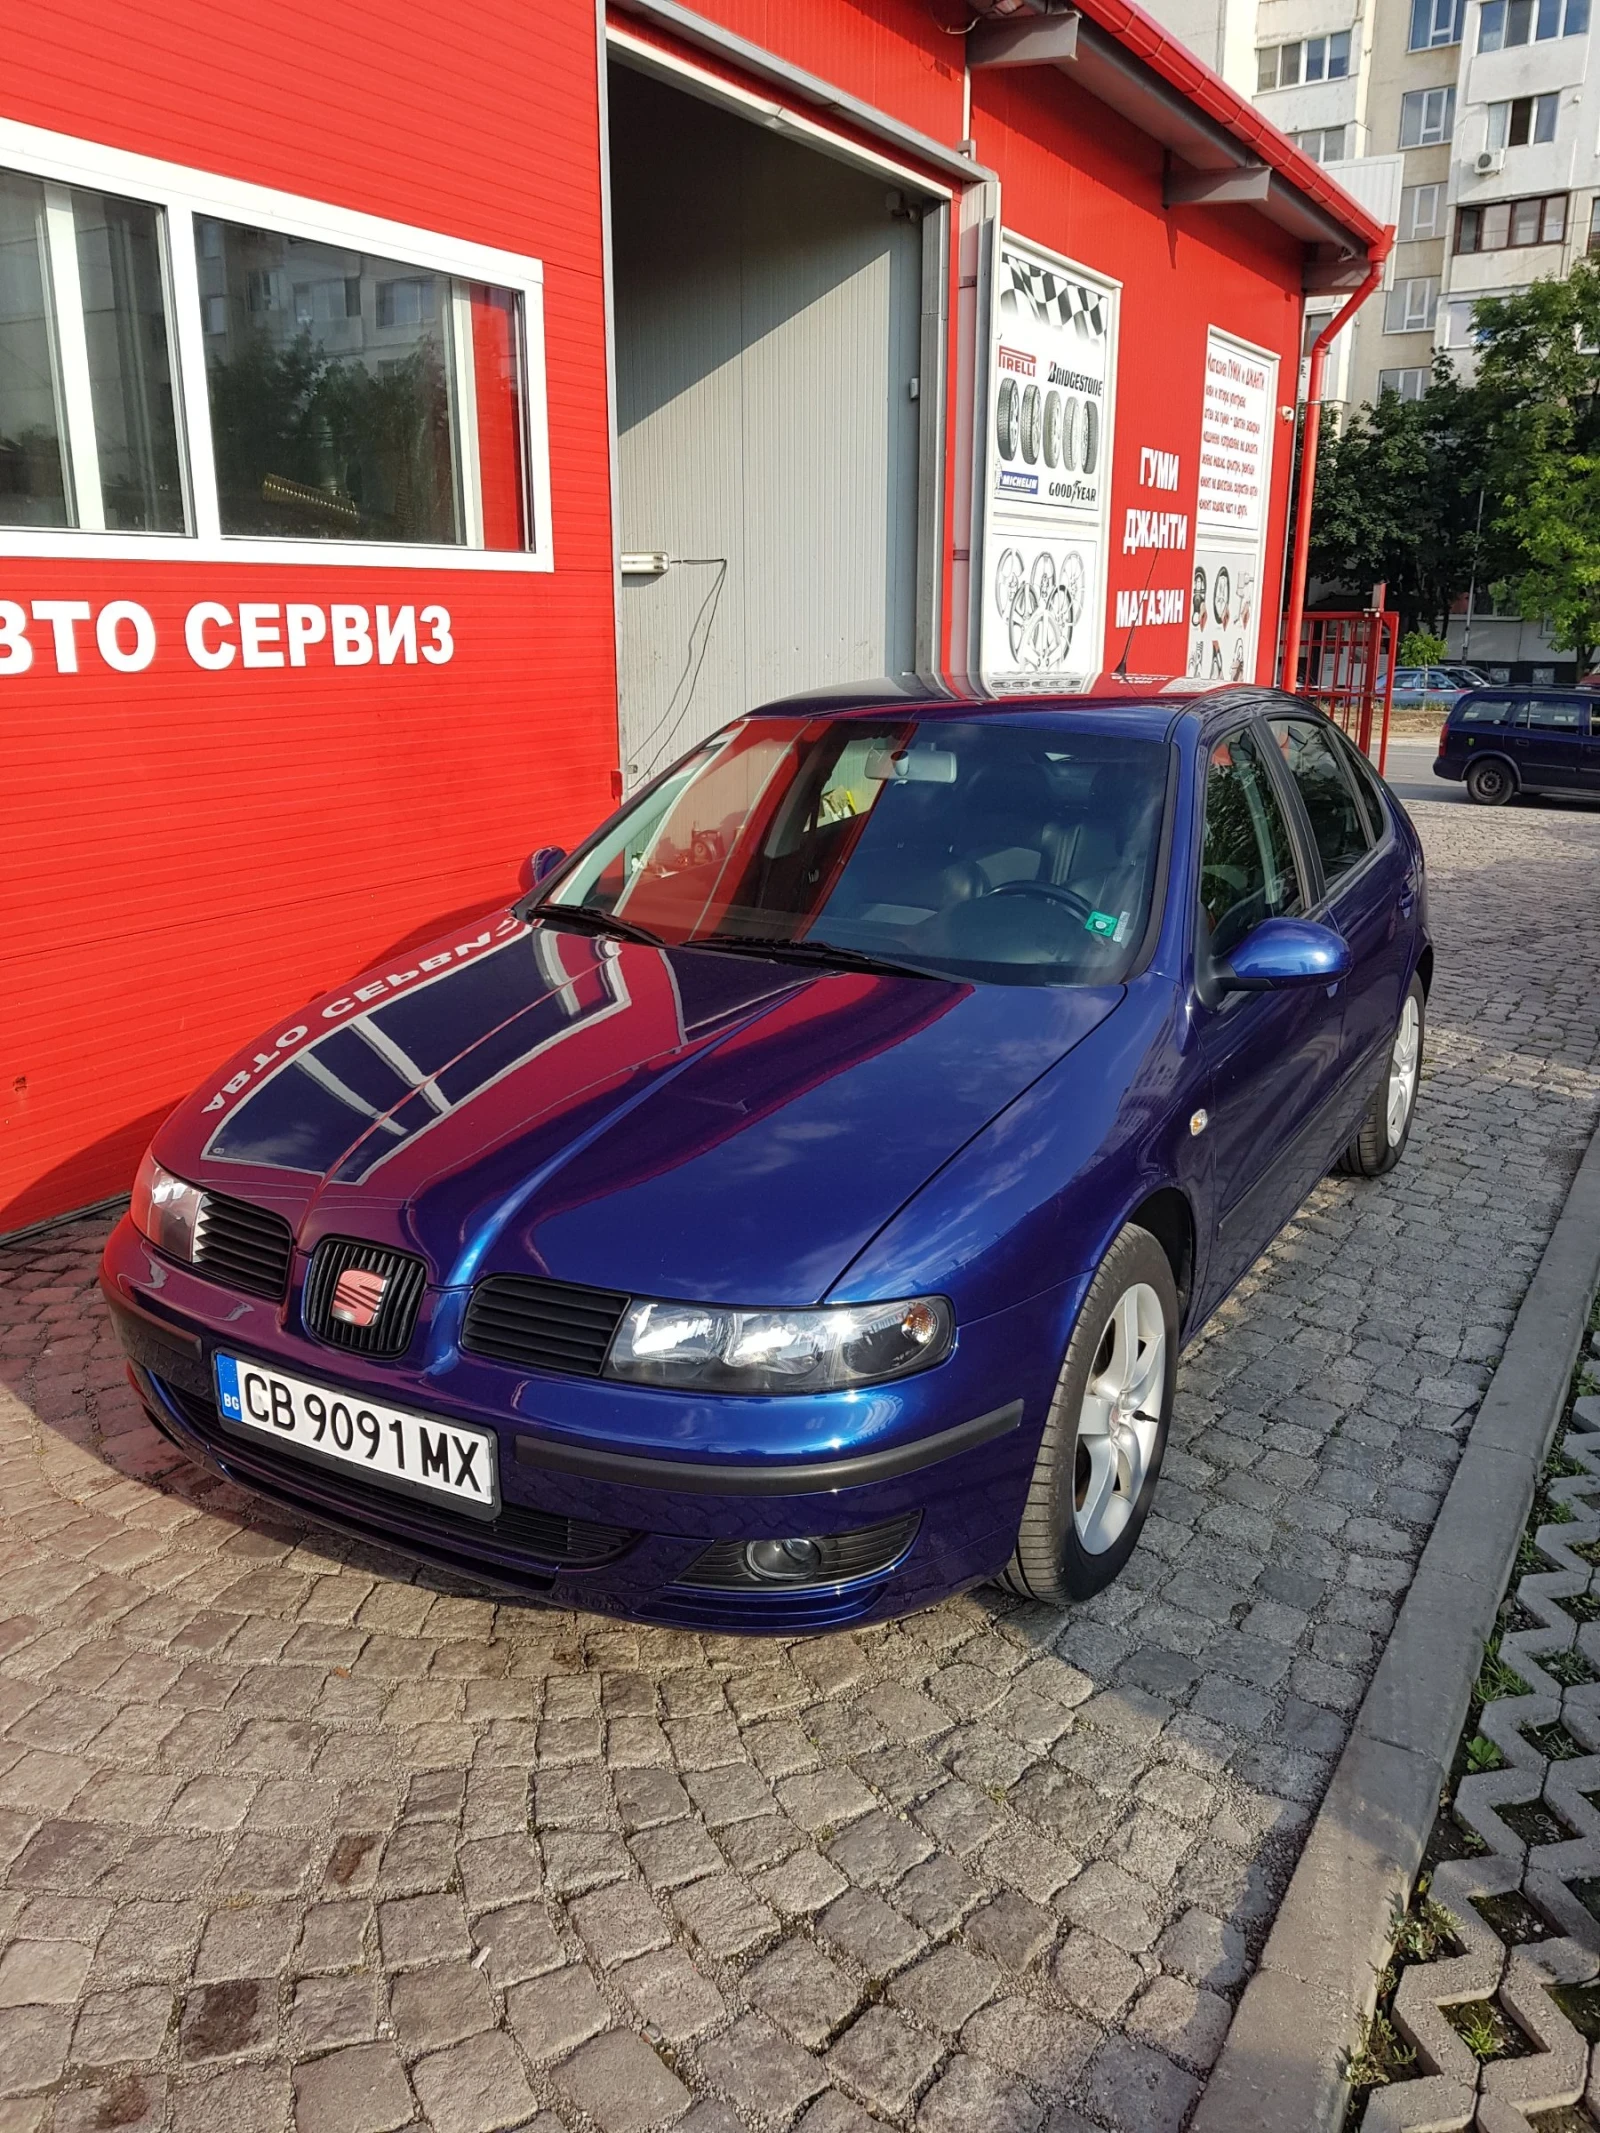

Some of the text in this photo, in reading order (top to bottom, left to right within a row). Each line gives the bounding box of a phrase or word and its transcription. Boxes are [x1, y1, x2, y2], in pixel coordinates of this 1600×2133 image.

[998, 345, 1037, 377] PIRELLI
[1047, 361, 1104, 397] BRIDGESTONE
[1002, 475, 1037, 489] MICHELIN
[1139, 446, 1180, 491] ГУМИ
[1123, 508, 1188, 555] ДЖАНТИ
[1115, 589, 1184, 628] МАГАЗИН
[184, 601, 454, 670] СЕРВИЗ
[223, 1393, 240, 1411] BG
